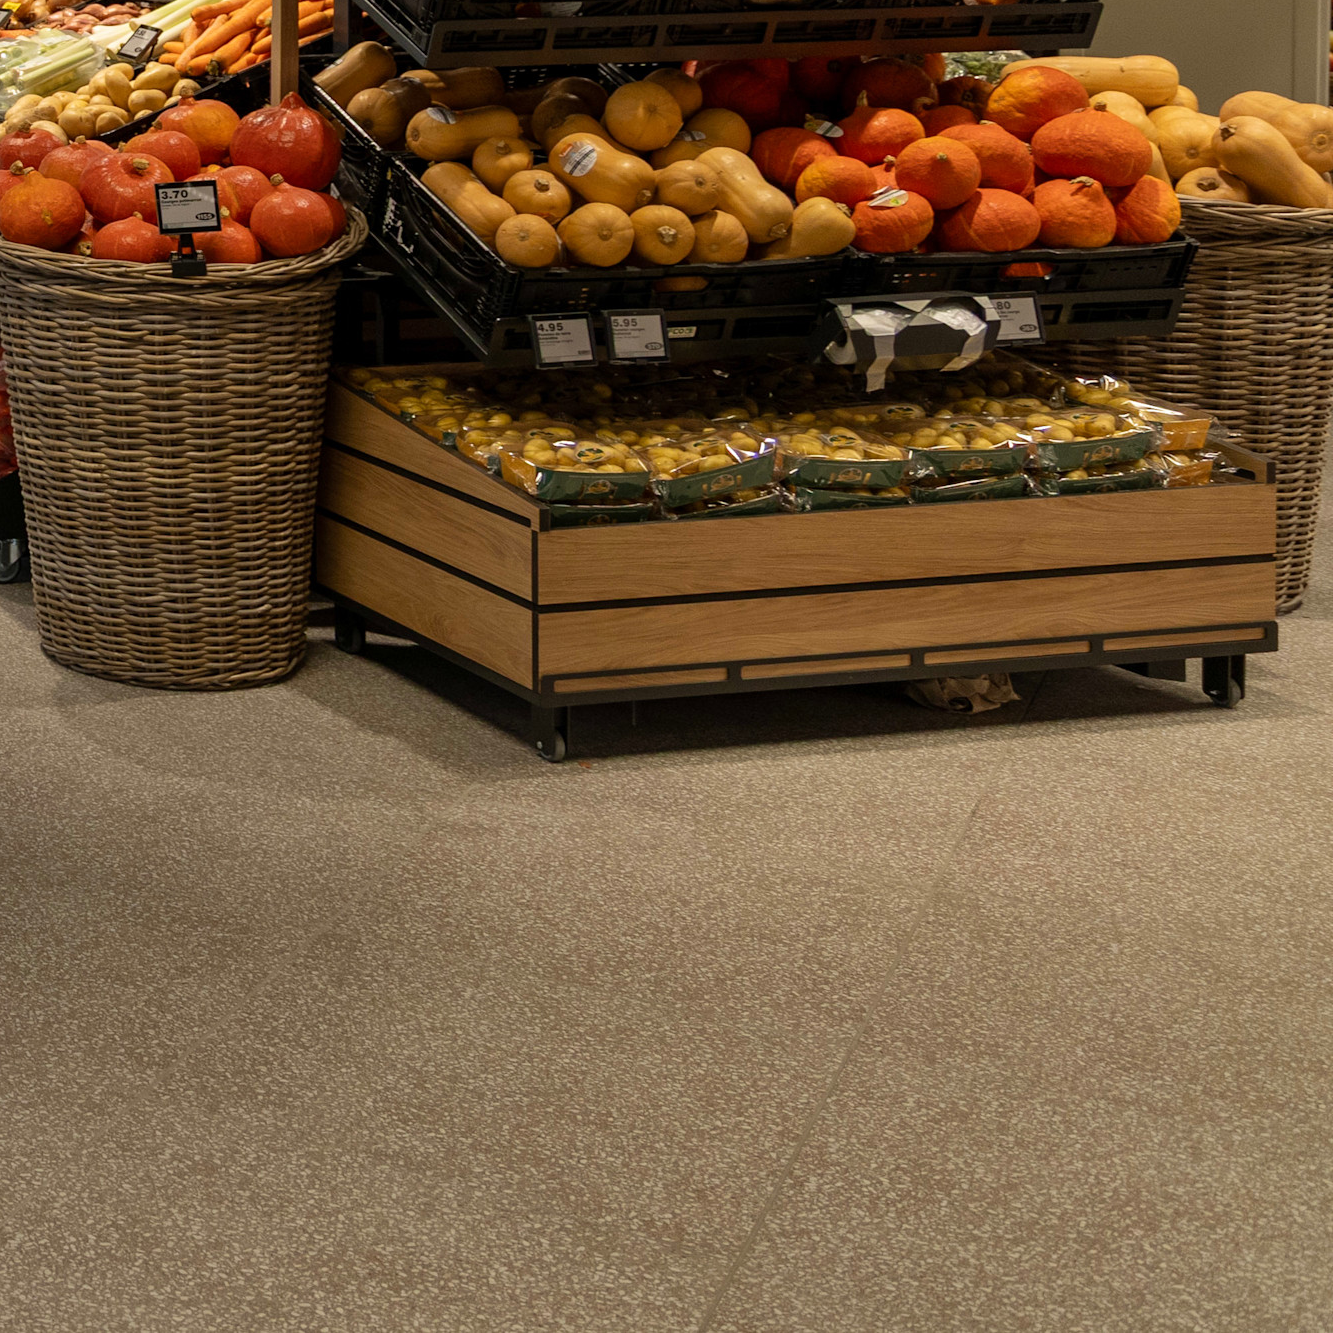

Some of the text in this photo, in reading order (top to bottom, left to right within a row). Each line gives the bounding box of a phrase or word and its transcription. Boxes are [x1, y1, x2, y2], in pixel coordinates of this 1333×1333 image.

[161, 189, 188, 200] 3.70
[537, 322, 564, 332] 4.95
[612, 318, 638, 328] 5.95
